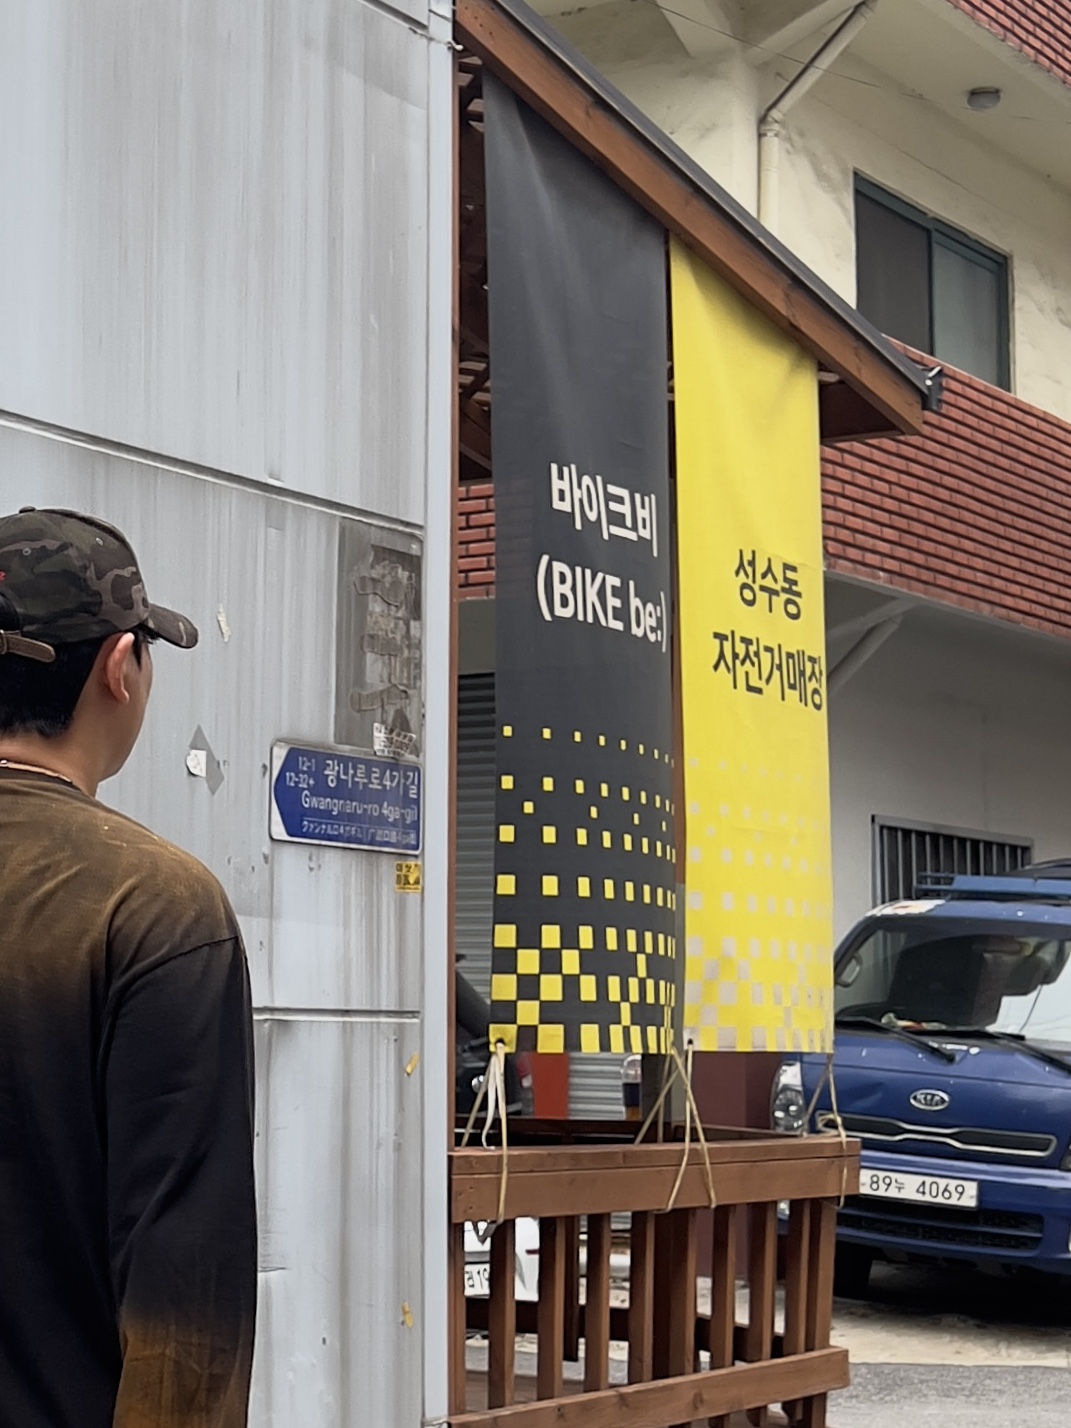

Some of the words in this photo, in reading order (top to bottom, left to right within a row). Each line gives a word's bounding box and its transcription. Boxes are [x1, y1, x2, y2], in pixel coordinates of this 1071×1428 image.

[550, 462, 658, 557] 바이크비
[536, 554, 624, 632] (BIKE
[734, 548, 802, 621] 성수동
[712, 630, 823, 711] 자전거매장
[301, 790, 380, 815] Gwangnaru-ro
[869, 1173, 906, 1194] 89누
[915, 1179, 966, 1202] 4069
